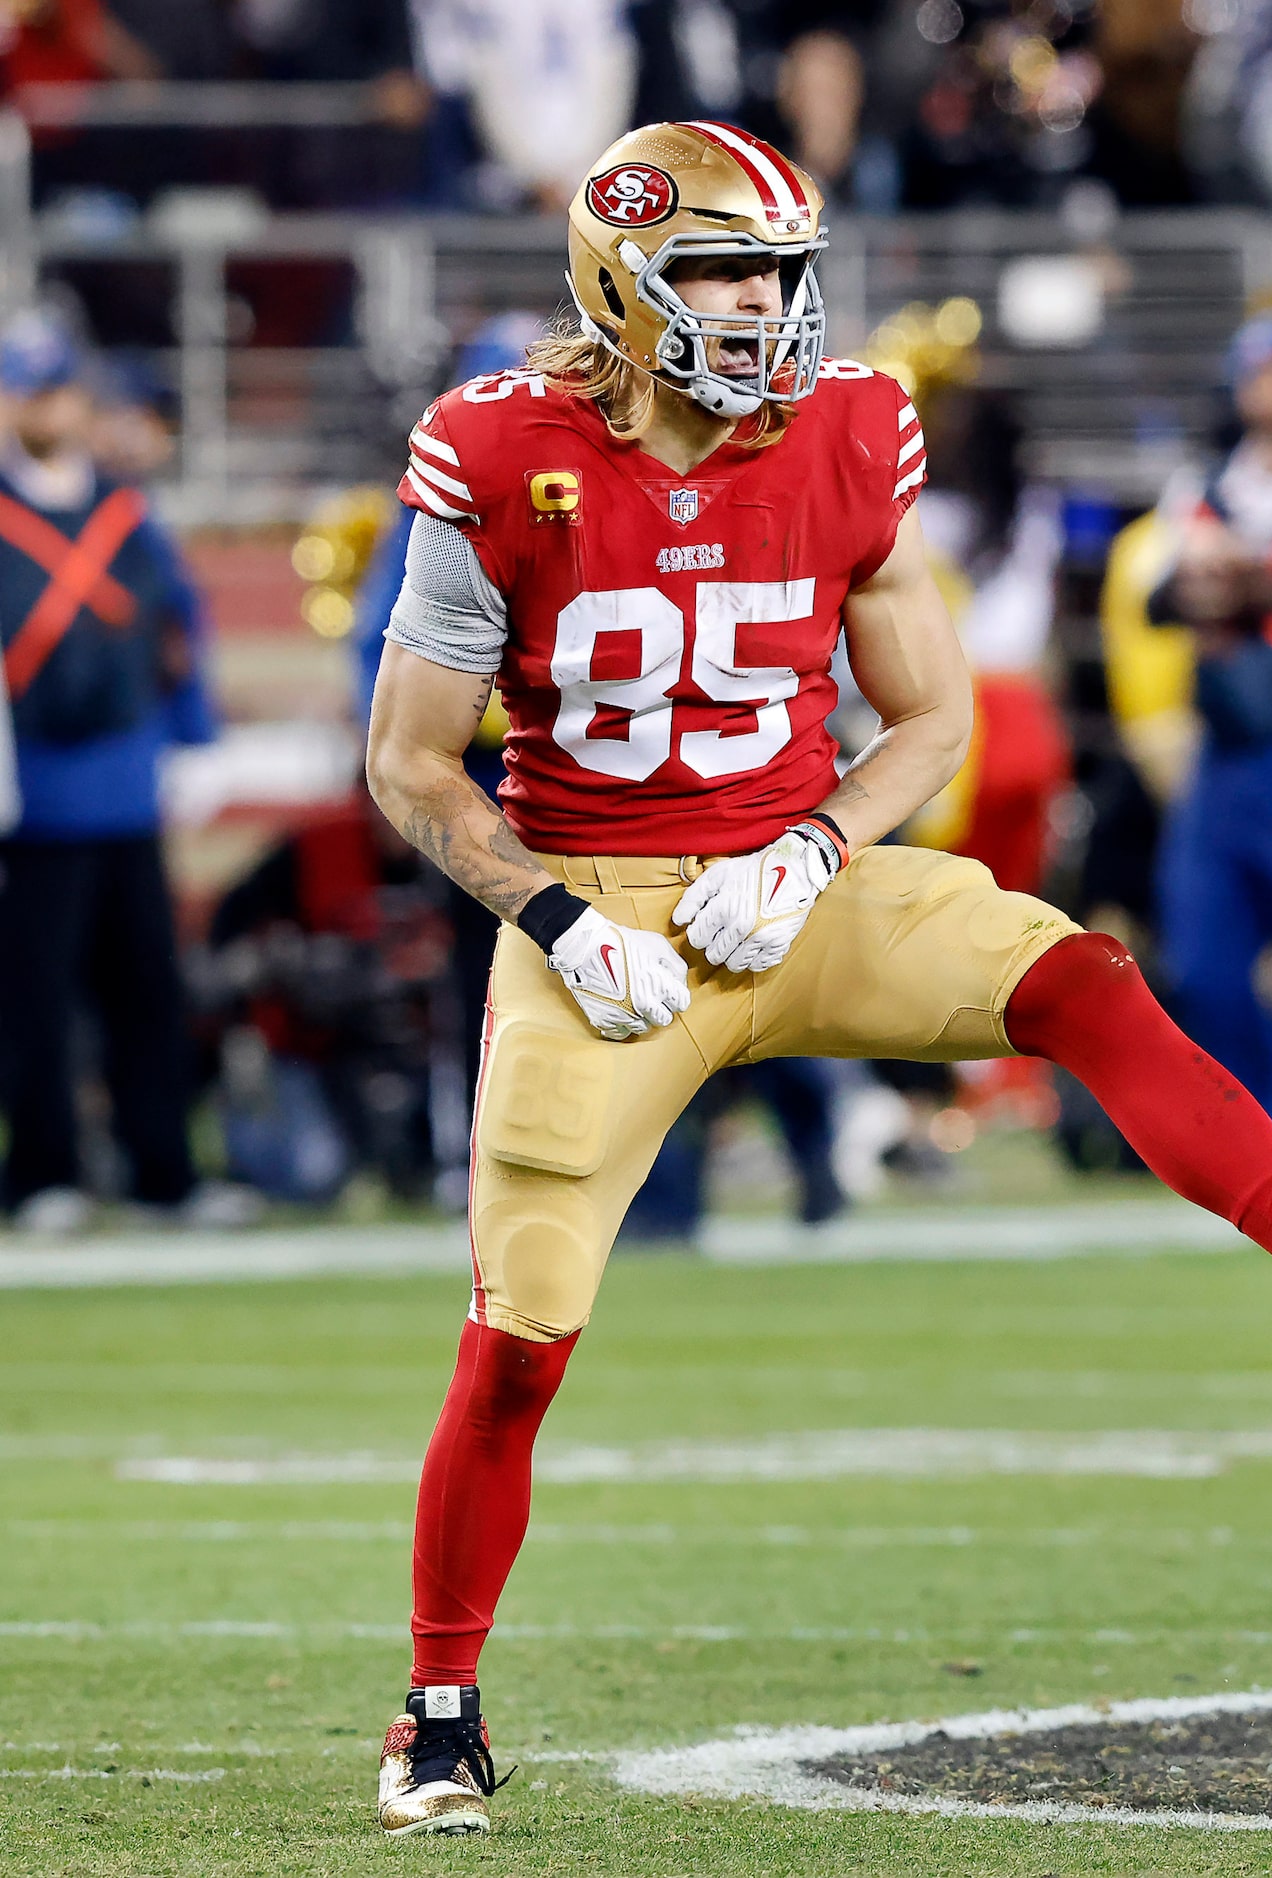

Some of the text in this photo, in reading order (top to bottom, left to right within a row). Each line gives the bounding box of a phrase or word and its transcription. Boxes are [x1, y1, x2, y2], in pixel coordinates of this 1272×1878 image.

[530, 472, 579, 511] C
[674, 503, 694, 517] NFL
[655, 542, 726, 573] 49ERS
[551, 577, 816, 782] 85
